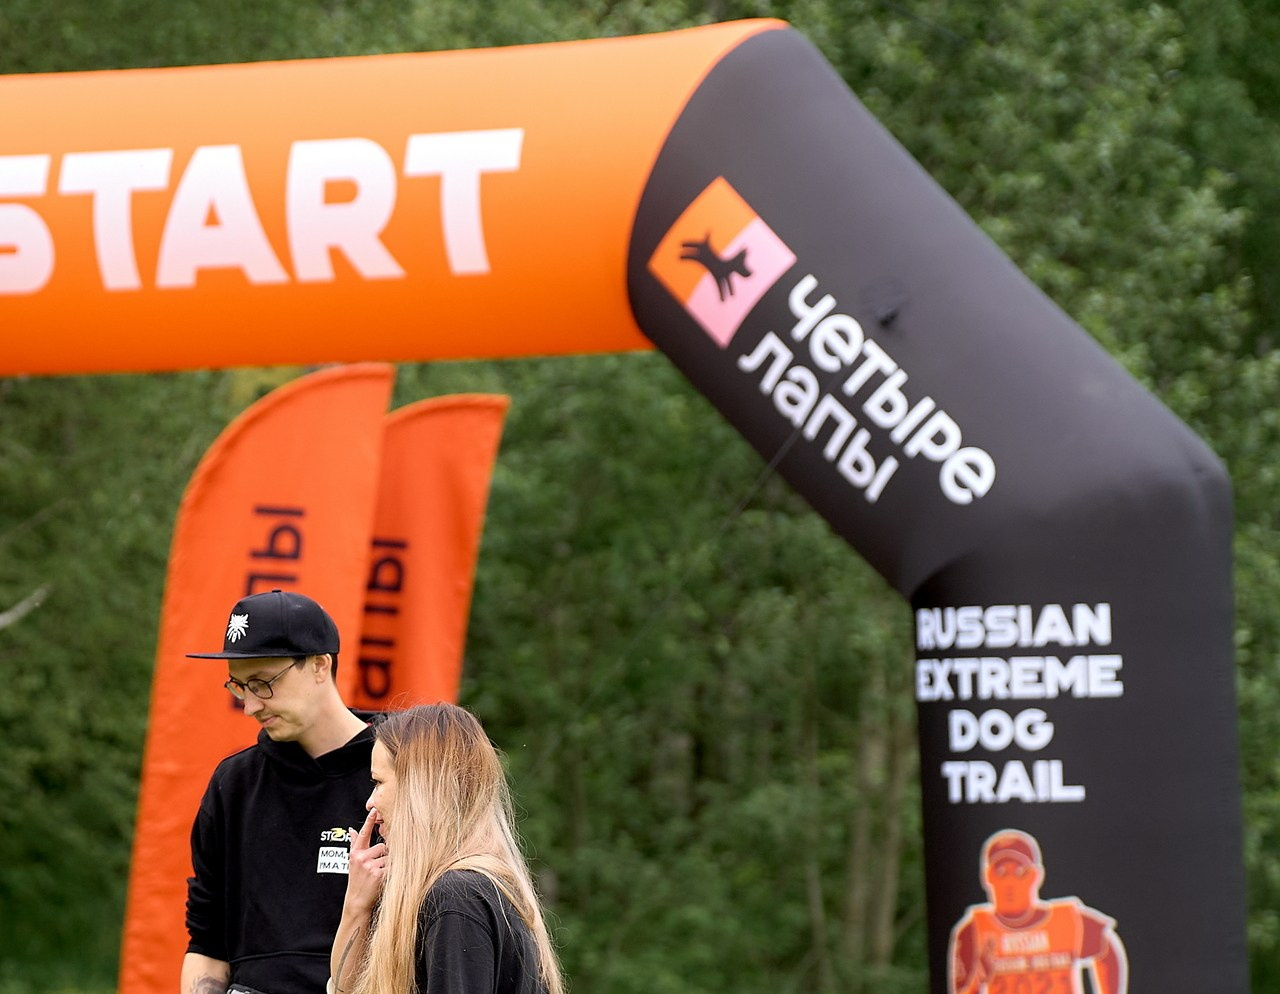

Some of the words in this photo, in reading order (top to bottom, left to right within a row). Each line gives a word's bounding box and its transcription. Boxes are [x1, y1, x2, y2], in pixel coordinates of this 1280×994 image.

[787, 273, 998, 506] четыре
[737, 331, 900, 505] лапы
[916, 603, 1112, 650] RUSSIAN
[916, 655, 1123, 701] EXTREME
[948, 708, 1054, 752] DOG
[941, 759, 1086, 803] TRAIL
[321, 850, 346, 859] MOM,
